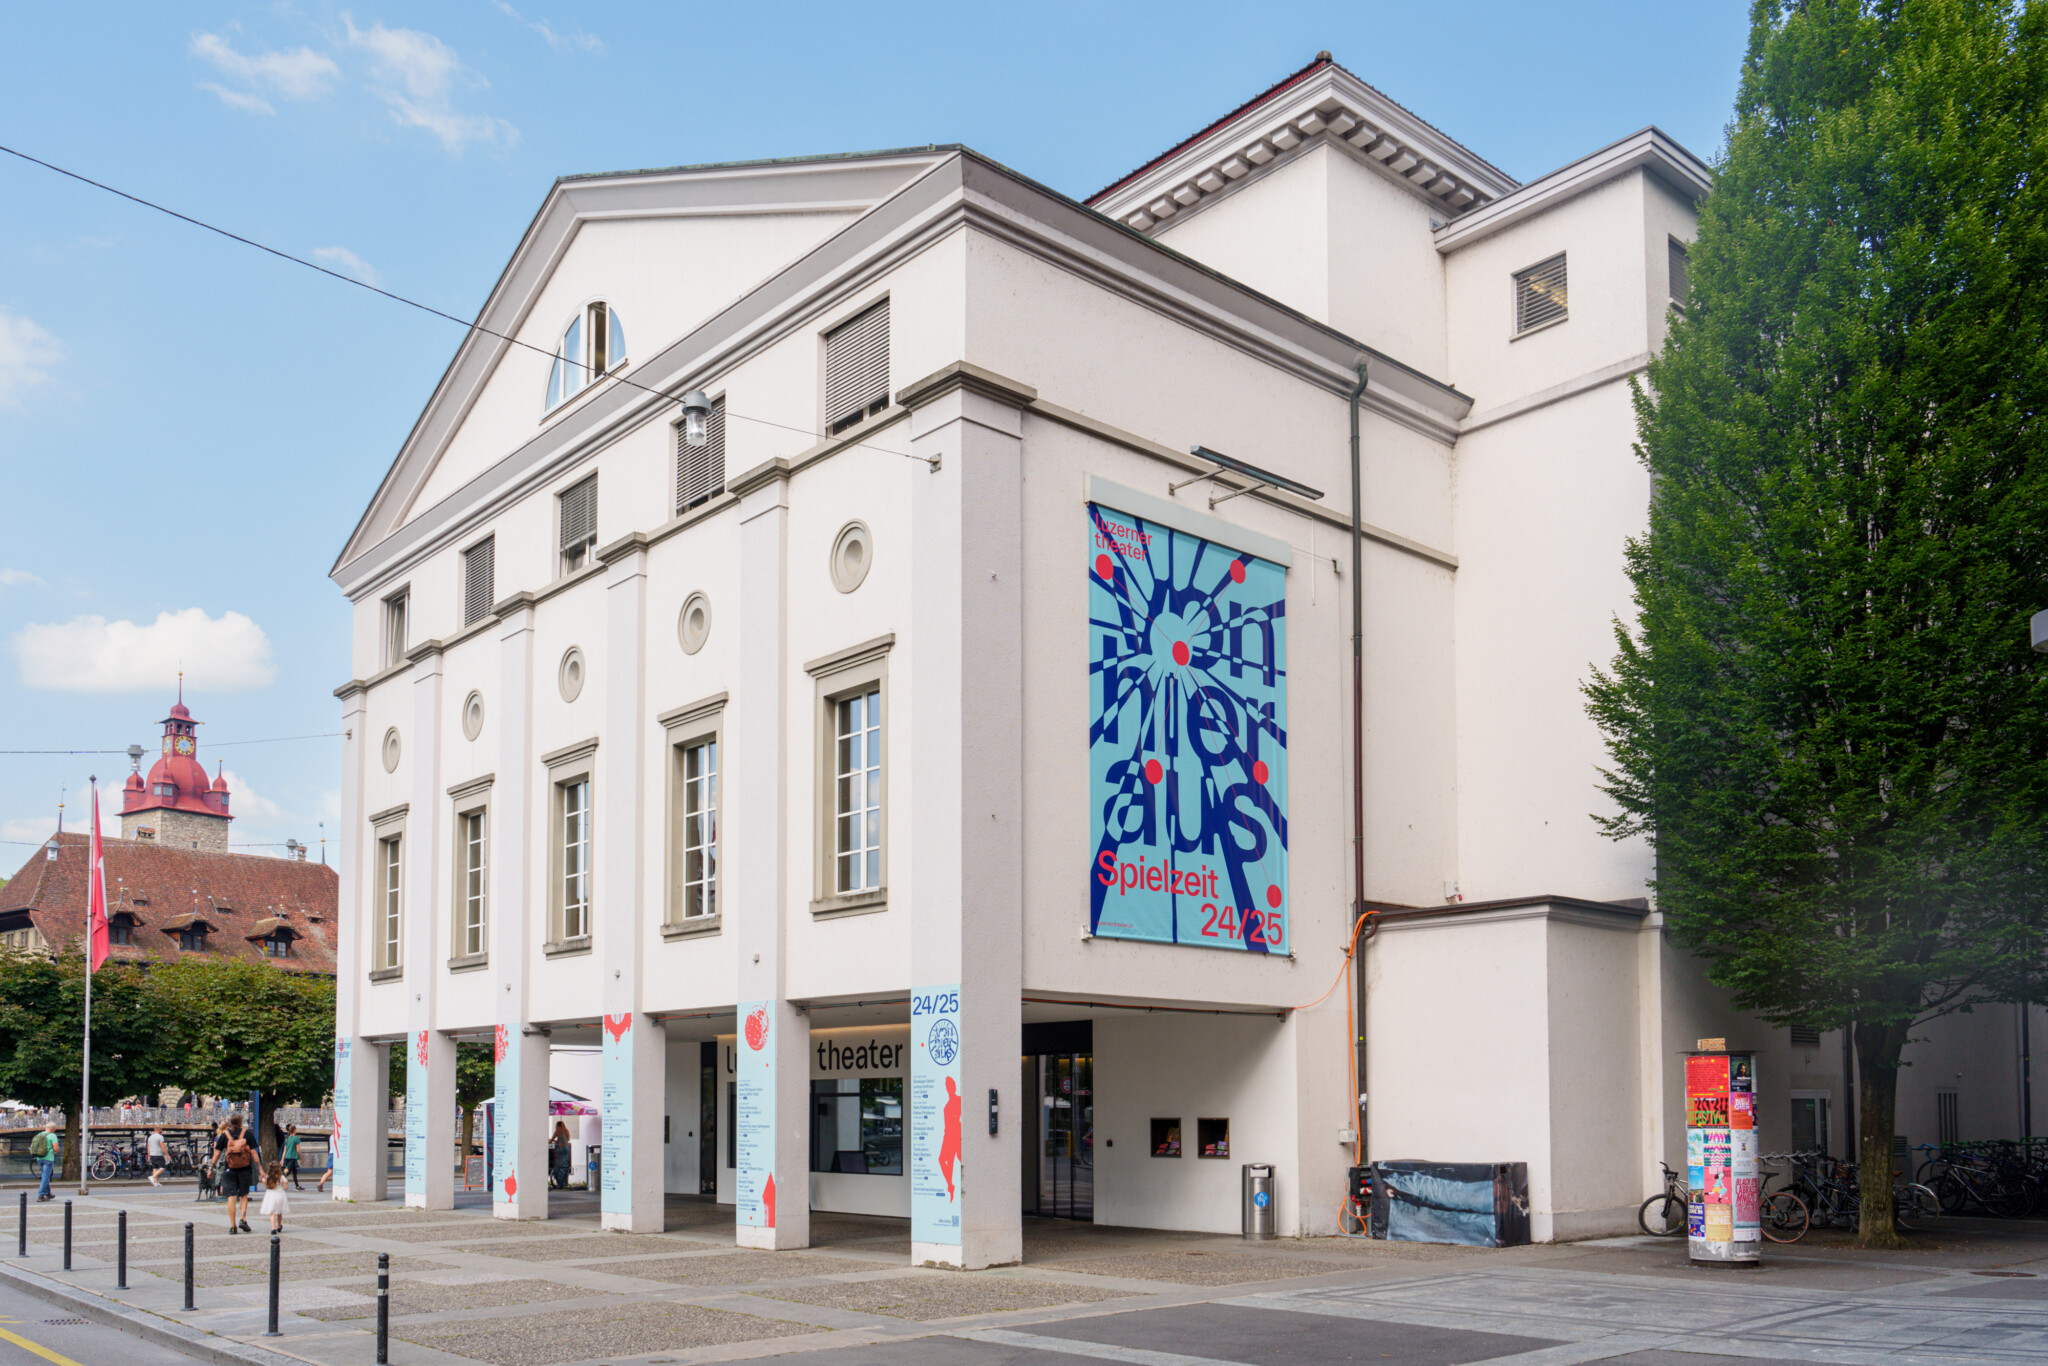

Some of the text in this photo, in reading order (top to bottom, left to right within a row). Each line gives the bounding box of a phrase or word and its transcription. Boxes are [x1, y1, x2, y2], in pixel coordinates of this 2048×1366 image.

[1095, 513, 1153, 546] luzerner
[1094, 532, 1147, 561] theater
[1098, 850, 1219, 900] Spielzeit
[1200, 903, 1283, 945] 24/25
[912, 993, 959, 1016] 24/25
[816, 1039, 903, 1071] theater
[1695, 1110, 1729, 1125] FESTIVAL
[1707, 1215, 1731, 1225] LINE
